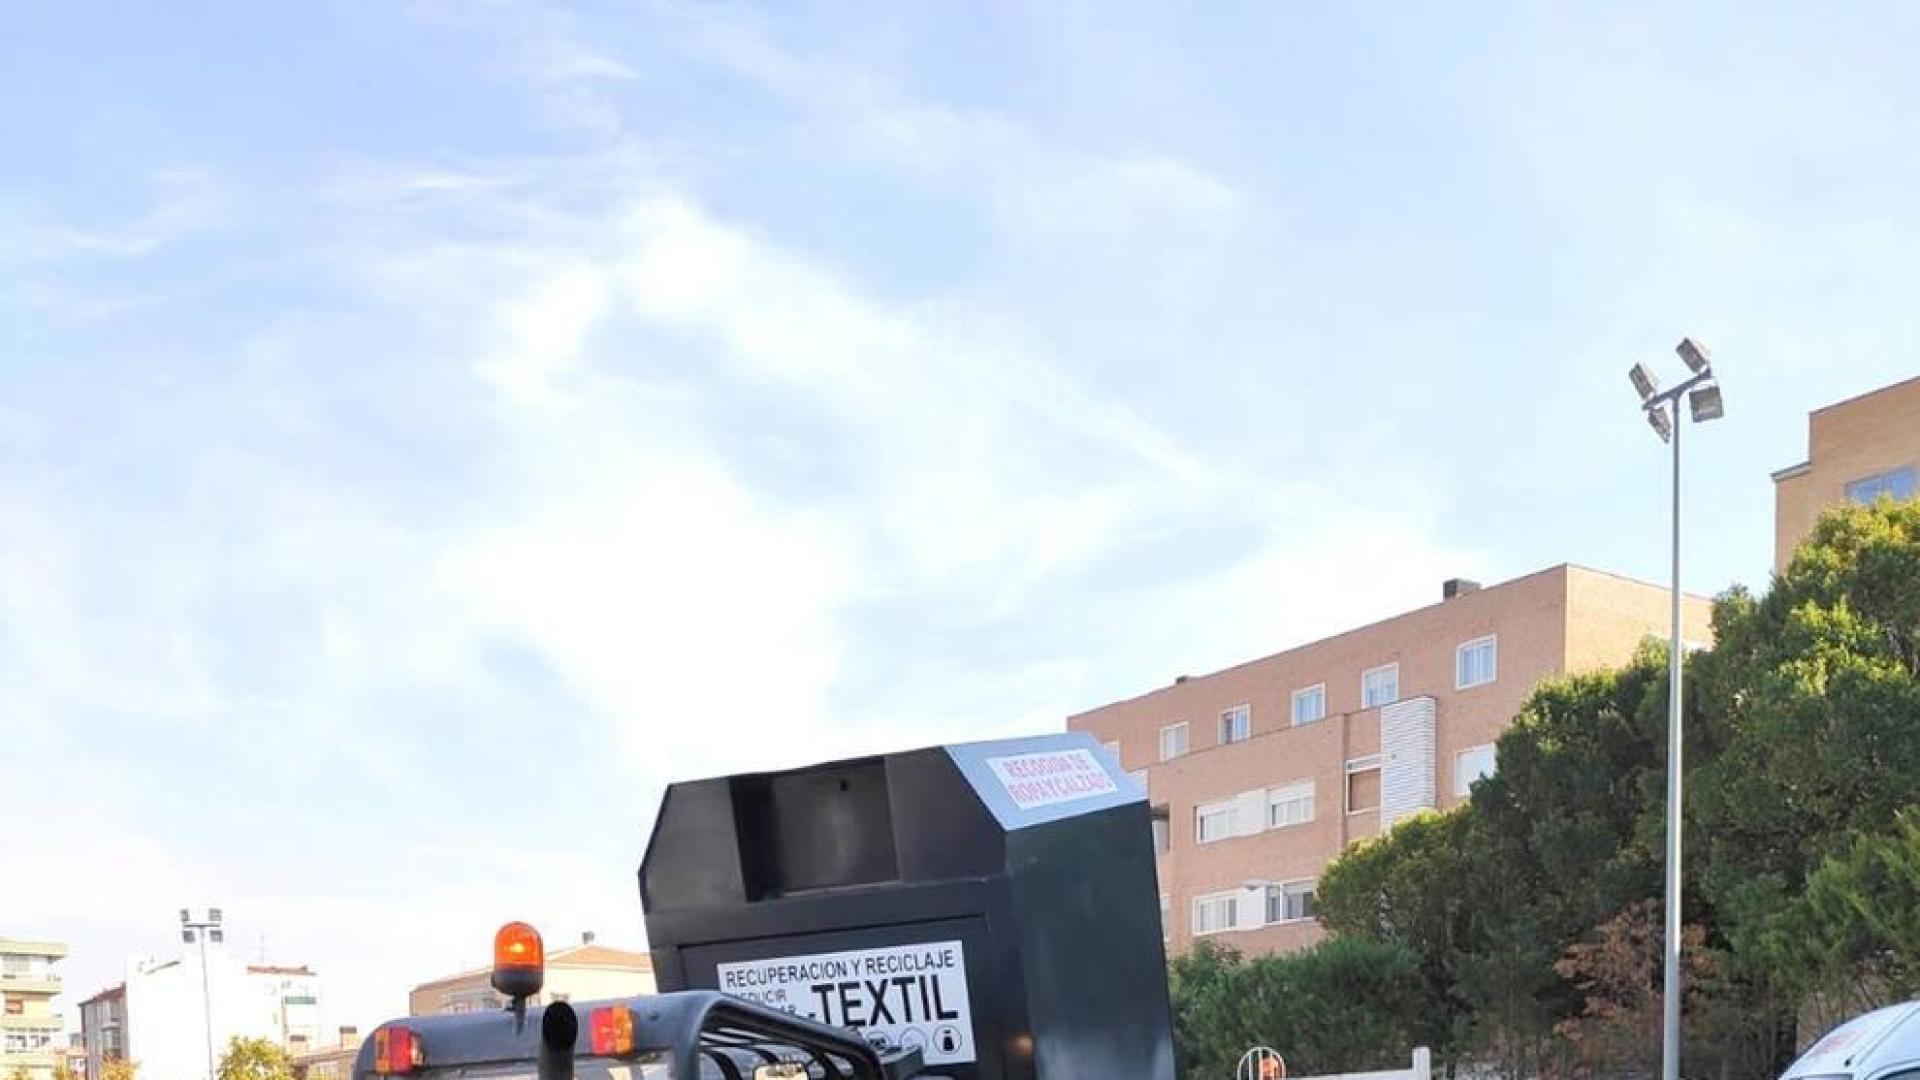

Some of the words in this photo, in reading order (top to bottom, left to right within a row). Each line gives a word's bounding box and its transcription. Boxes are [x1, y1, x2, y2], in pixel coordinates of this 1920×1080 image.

[726, 962, 847, 988] RECUPERACION
[851, 960, 862, 976] Y
[865, 950, 955, 974] RECICLAJE
